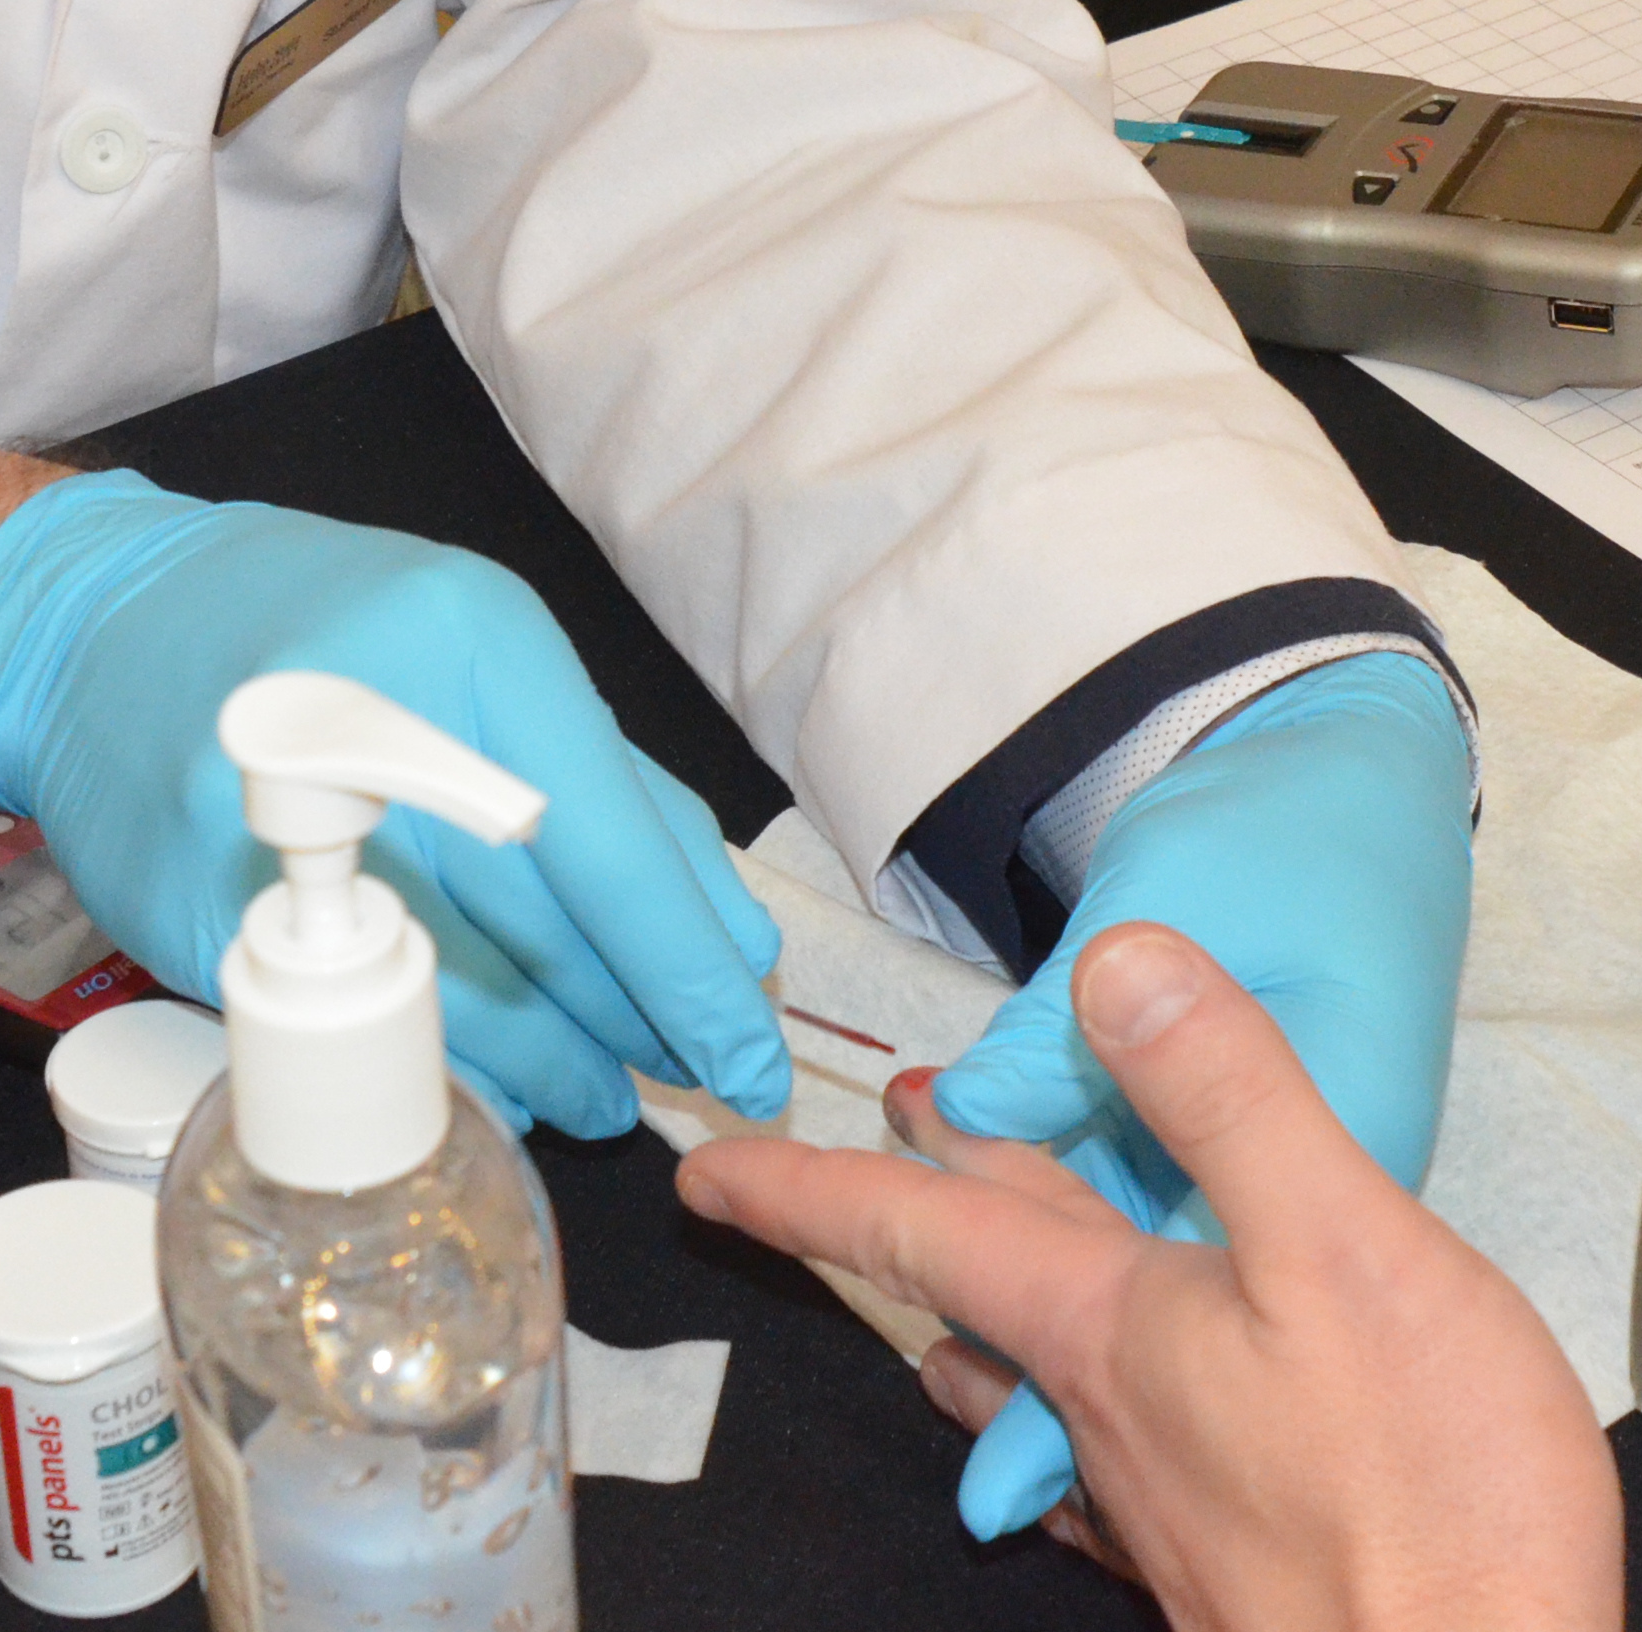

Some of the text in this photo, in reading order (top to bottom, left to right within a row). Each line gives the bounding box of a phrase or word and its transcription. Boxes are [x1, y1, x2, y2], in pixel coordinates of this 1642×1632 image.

[73, 956, 138, 999] eliOn
[90, 1377, 169, 1424] CHOL
[93, 1426, 122, 1442] Test
[25, 1414, 85, 1562] pts panels
